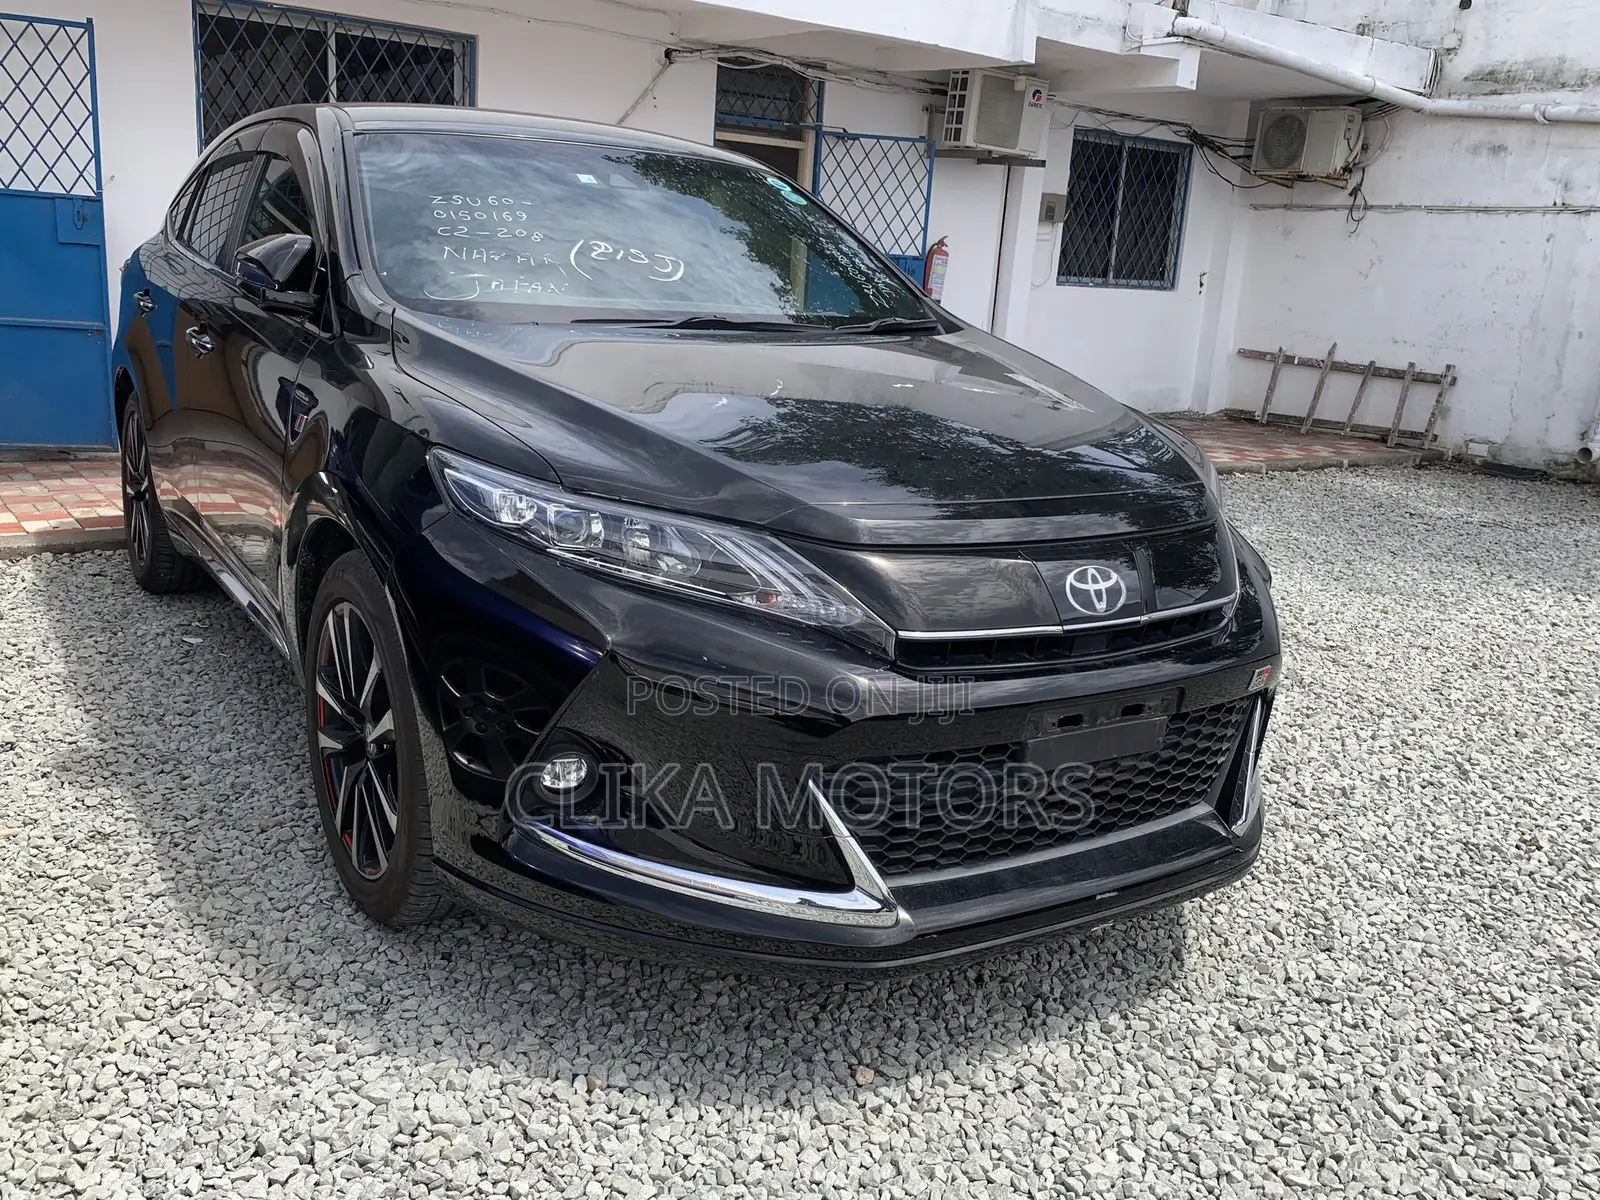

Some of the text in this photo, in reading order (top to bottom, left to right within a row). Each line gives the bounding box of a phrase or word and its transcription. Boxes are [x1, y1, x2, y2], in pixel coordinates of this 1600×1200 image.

[1028, 101, 1044, 109] GREE
[433, 209, 527, 222] 0150169
[437, 226, 544, 242] C2-208
